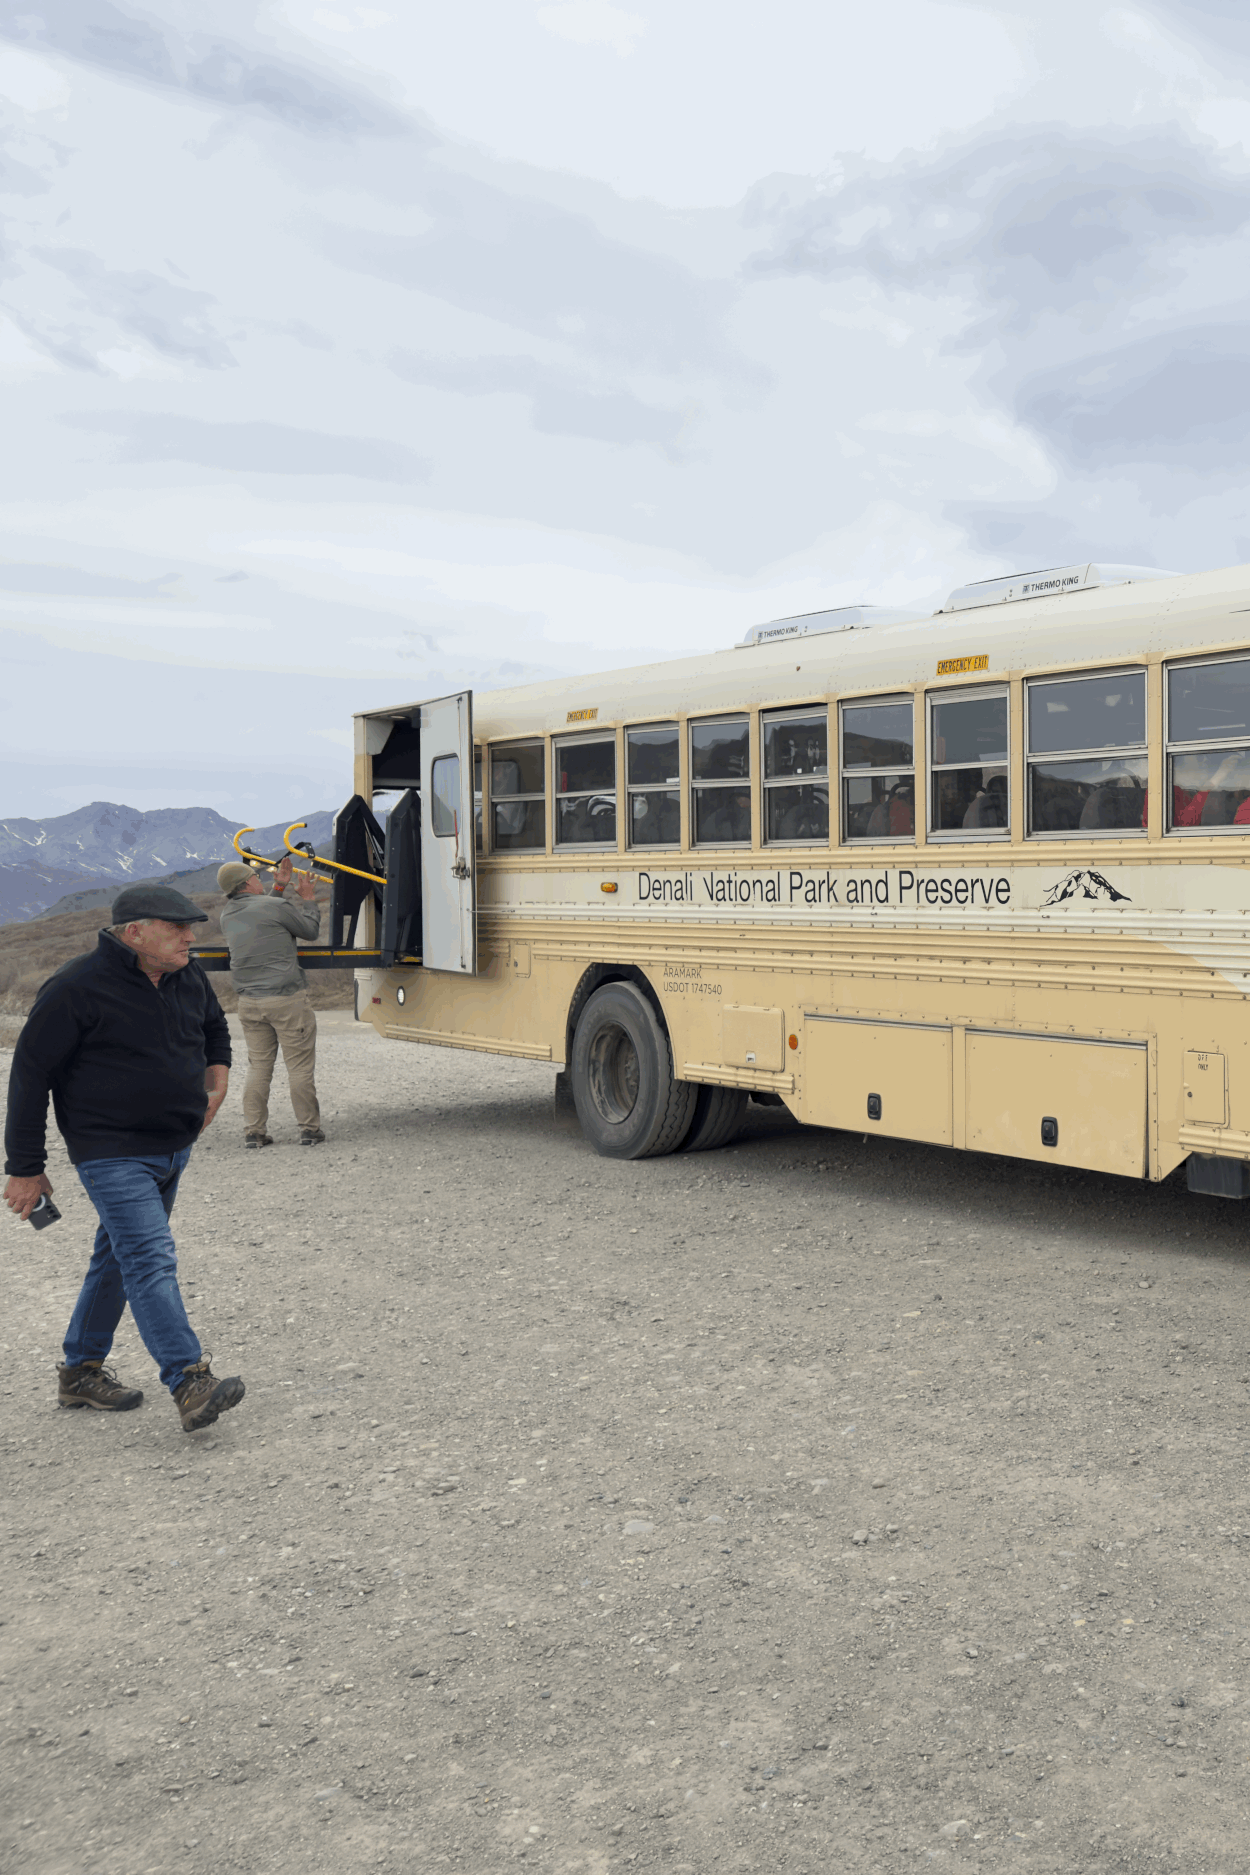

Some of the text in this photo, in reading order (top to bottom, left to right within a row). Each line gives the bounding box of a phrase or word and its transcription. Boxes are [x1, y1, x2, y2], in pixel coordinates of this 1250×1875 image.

[1031, 575, 1079, 592] THERMO KING
[764, 625, 798, 639] THERMO KING
[937, 655, 988, 674] EMERGENCY EXIT
[638, 869, 1011, 905] Denali National Park and Preserve
[663, 967, 702, 979] ARAMARK
[663, 981, 723, 995] USDOT 1747540
